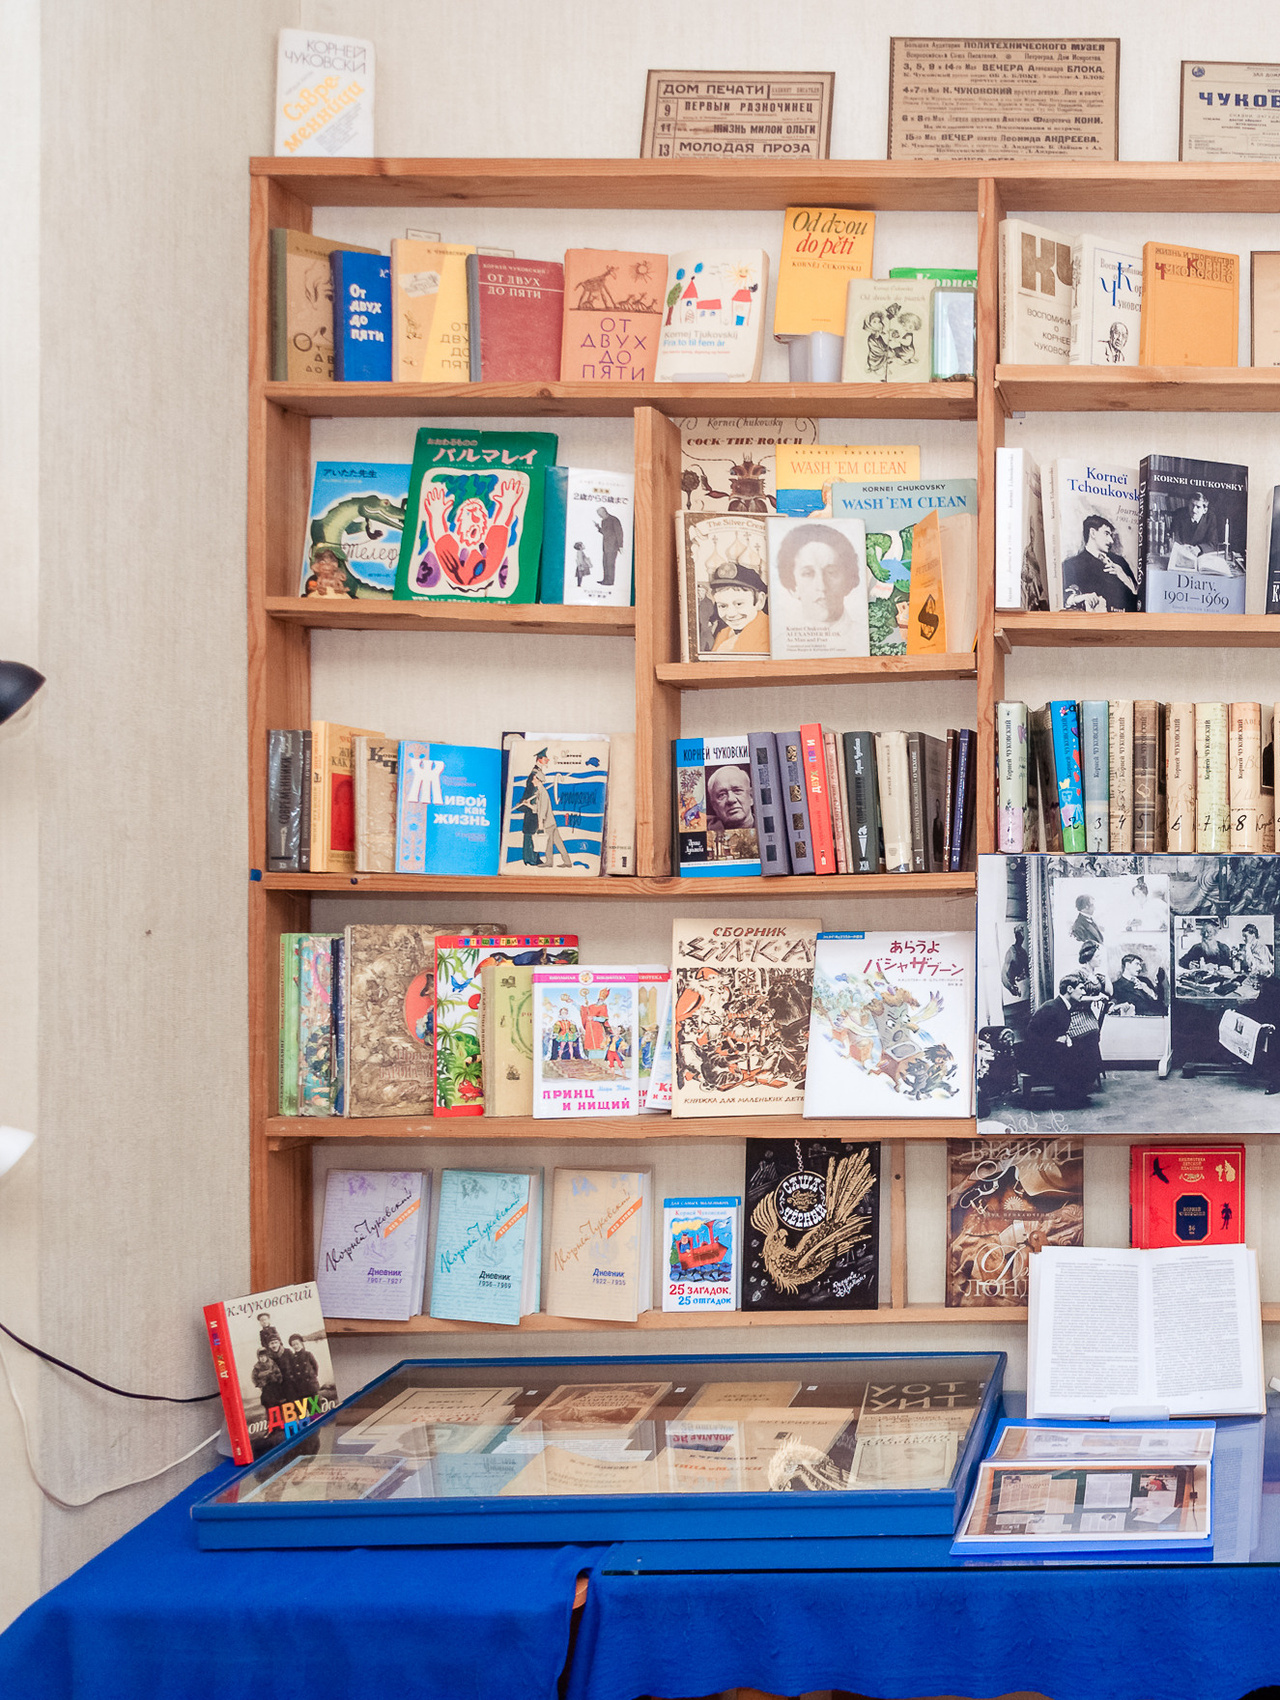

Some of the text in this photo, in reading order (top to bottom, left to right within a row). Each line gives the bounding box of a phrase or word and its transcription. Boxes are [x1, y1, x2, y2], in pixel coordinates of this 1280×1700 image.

[306, 39, 367, 59] КОРНЕЙ
[964, 42, 1105, 51] ПОЛИТЕХНИЧЕСКОГО МУЗЕЯ
[663, 84, 764, 95] ДОМ ПЕЧАТИ
[954, 87, 1012, 95] ЧУКОВСКИЙ
[665, 105, 671, 116] 9
[740, 103, 813, 112] РАЗНОЧИНЕЦ
[714, 125, 815, 133] ЖИЗНЬ ОЛЬГИ
[1045, 135, 1100, 143] АНДРЕЕВА.
[659, 145, 669, 156] 13
[680, 143, 810, 153] МОЛОДАЯ ПРОЗА
[792, 211, 867, 235] Od dvou
[796, 233, 855, 258] do pěti
[487, 273, 541, 287] ОТ ДВУХ
[487, 285, 542, 300] ДО ПЯТИ
[600, 317, 632, 333] ОТ
[581, 333, 647, 350] ДВУХ
[599, 350, 632, 365] ДО
[582, 365, 645, 381] ПЯТИ
[433, 448, 538, 465] バルマレイ
[790, 461, 831, 475] WASH
[864, 461, 907, 475] CLEAN
[1086, 466, 1129, 485] Korneï
[1153, 474, 1244, 491] KORNEI CHUKOVSKY
[897, 484, 946, 492] CHUKOVSKY
[842, 498, 883, 511] WASH
[925, 495, 967, 508] CLEAN
[723, 519, 742, 528] Silver
[1176, 574, 1217, 592] Diary,
[684, 745, 749, 761] КОРНЕЙ ЧУКОВСКИ
[464, 806, 486, 815] как
[1094, 817, 1102, 830] 3
[1202, 815, 1210, 830] 7
[1235, 814, 1248, 830] 8
[713, 926, 787, 937] СБОРНИК
[889, 940, 940, 954] あらうよ
[863, 957, 965, 976] バシャザブーン
[542, 1089, 594, 1099] ПРИНЦ
[562, 1098, 630, 1110] И НИЩИЙ
[782, 1174, 822, 1194] САША
[782, 1203, 827, 1228] ЧЁРНЫЙ
[367, 1268, 402, 1278] Дневник
[479, 1270, 511, 1281] Дневник
[592, 1268, 625, 1278] Дневник
[669, 1284, 685, 1295] 25
[678, 1296, 691, 1306] 25
[268, 1395, 322, 1433] ДВУХ
